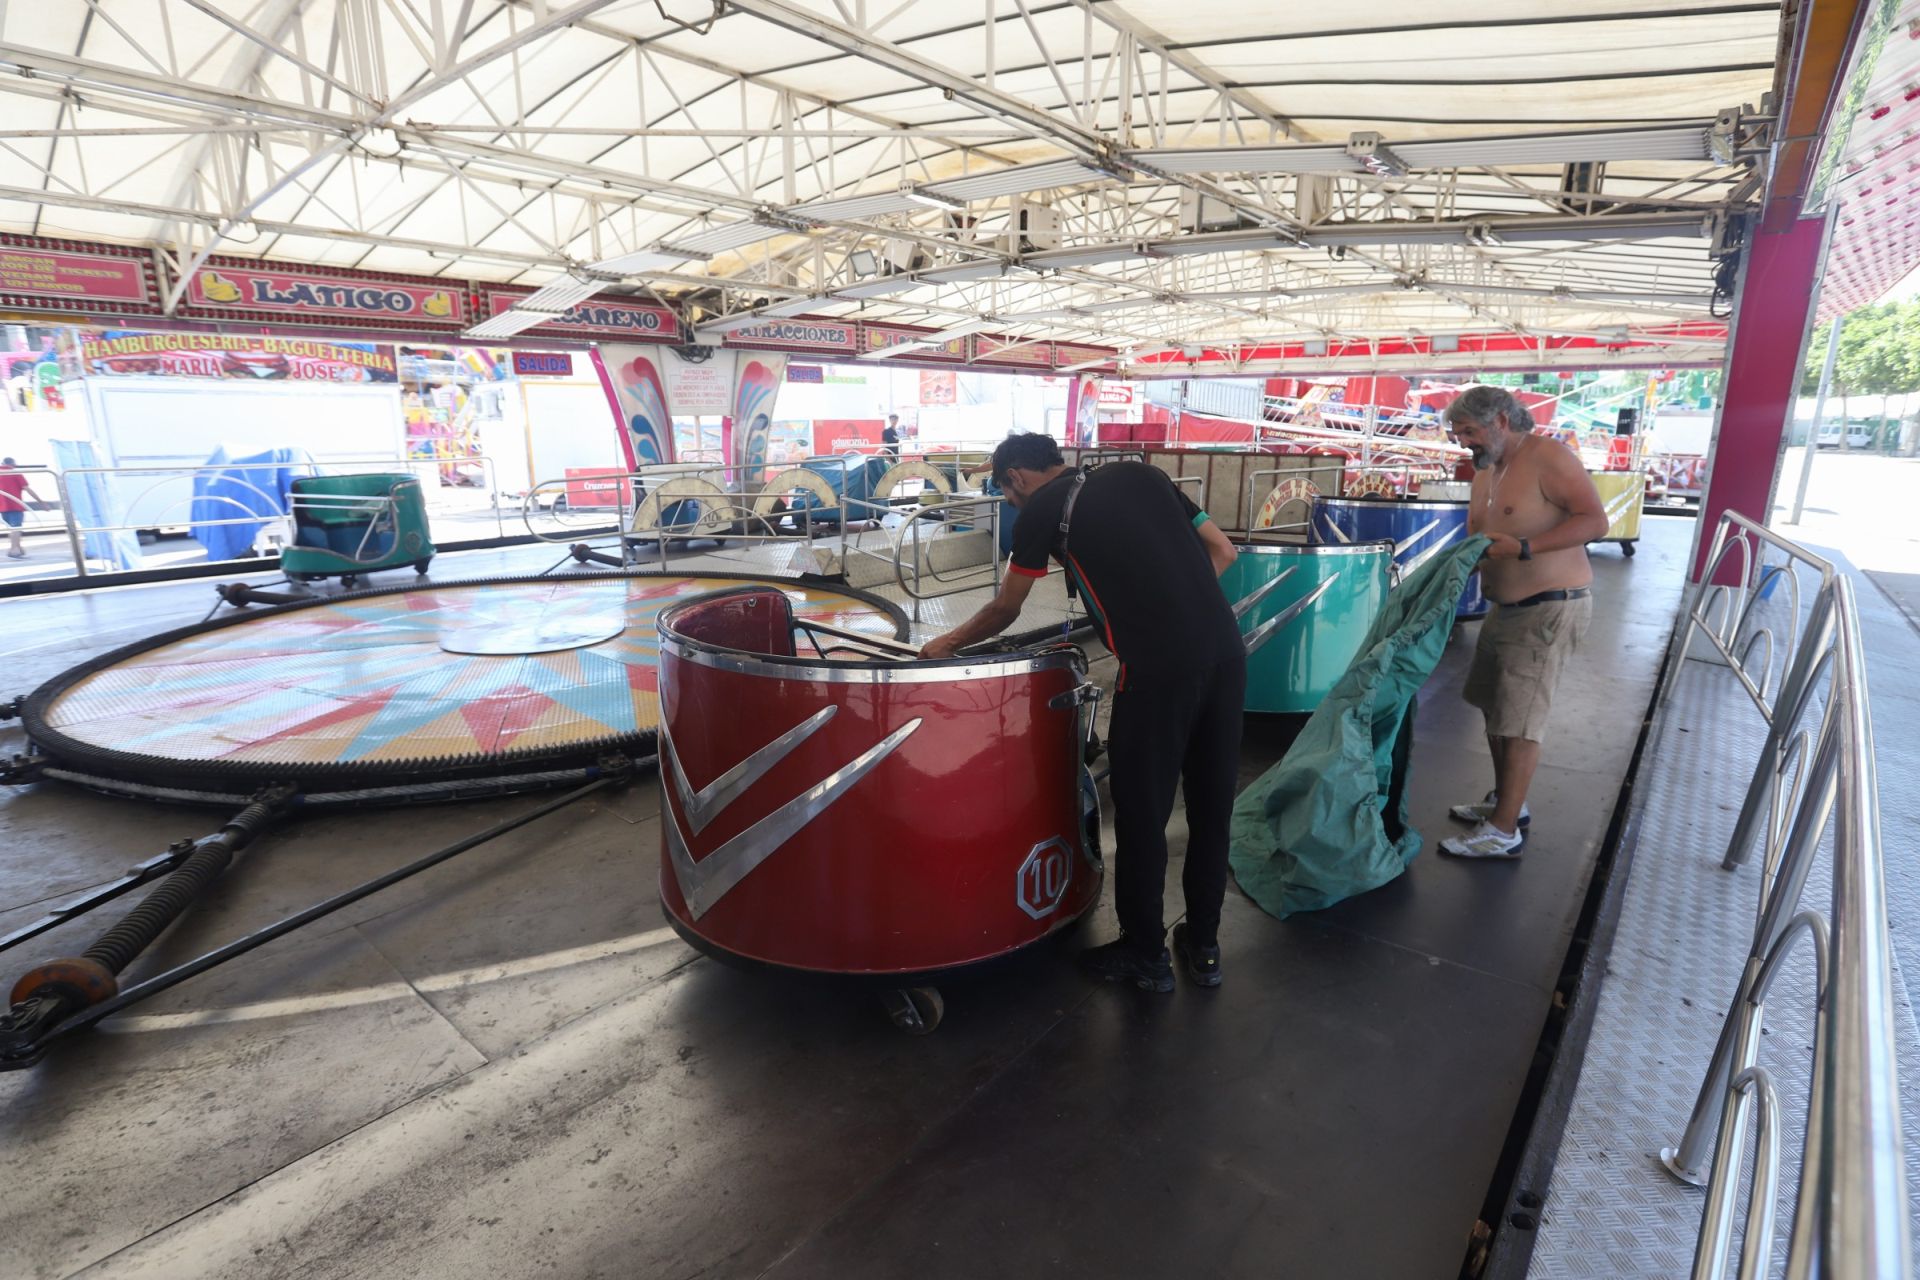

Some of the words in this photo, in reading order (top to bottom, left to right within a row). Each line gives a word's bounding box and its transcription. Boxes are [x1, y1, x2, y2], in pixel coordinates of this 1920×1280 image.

[250, 279, 413, 312] LATIGO
[84, 334, 250, 359] HAMBURGUESERIA
[263, 338, 394, 372] BAGUETTERIA
[162, 358, 223, 377] MARIA
[518, 356, 568, 371] SALIDA
[790, 367, 820, 380] SALIDA
[584, 481, 624, 491] Cruzcamo
[1030, 853, 1063, 904] 10
